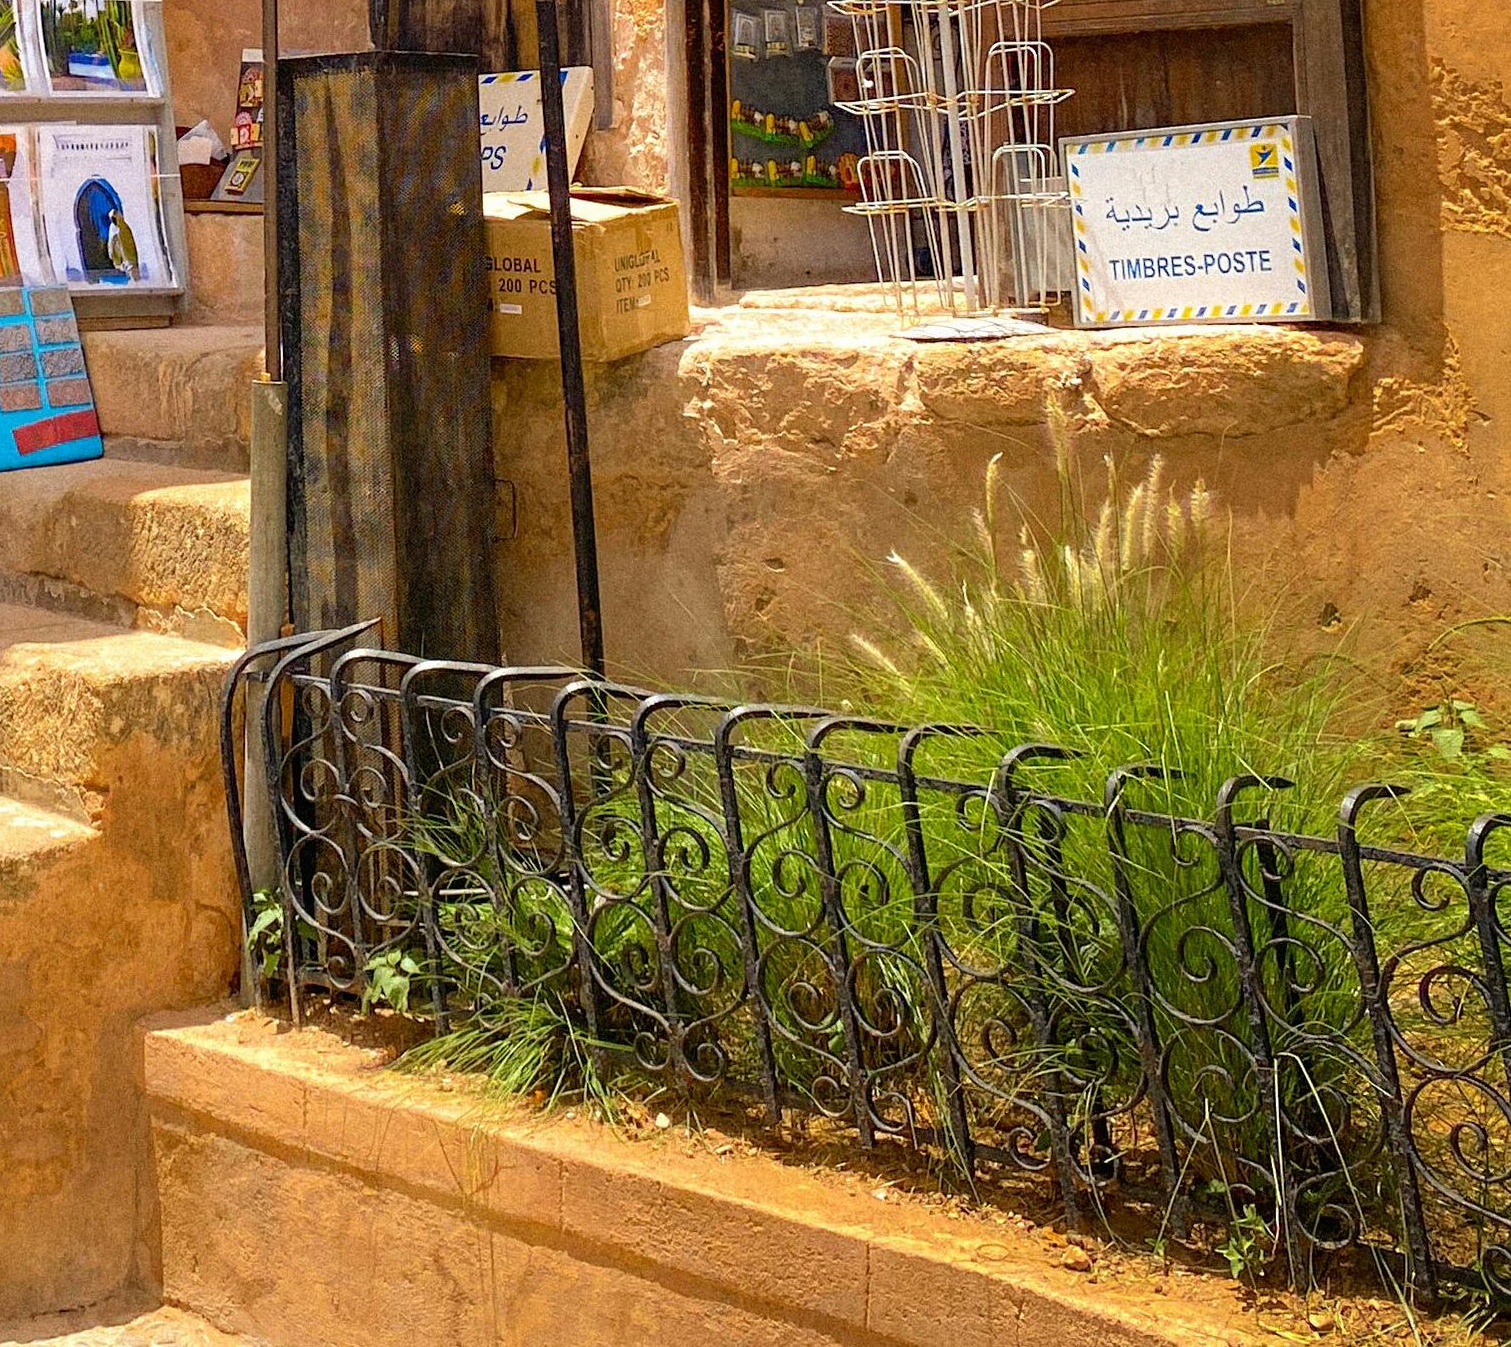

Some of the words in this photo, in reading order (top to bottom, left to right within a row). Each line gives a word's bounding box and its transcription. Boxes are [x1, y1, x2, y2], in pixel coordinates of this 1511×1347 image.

[1105, 196, 1180, 232] بريدية
[1192, 185, 1265, 232] طوابع
[654, 267, 670, 284] PCS
[1109, 250, 1273, 281] TIMBRES-POSTE
[498, 278, 522, 293] 200
[529, 279, 557, 295] PCS
